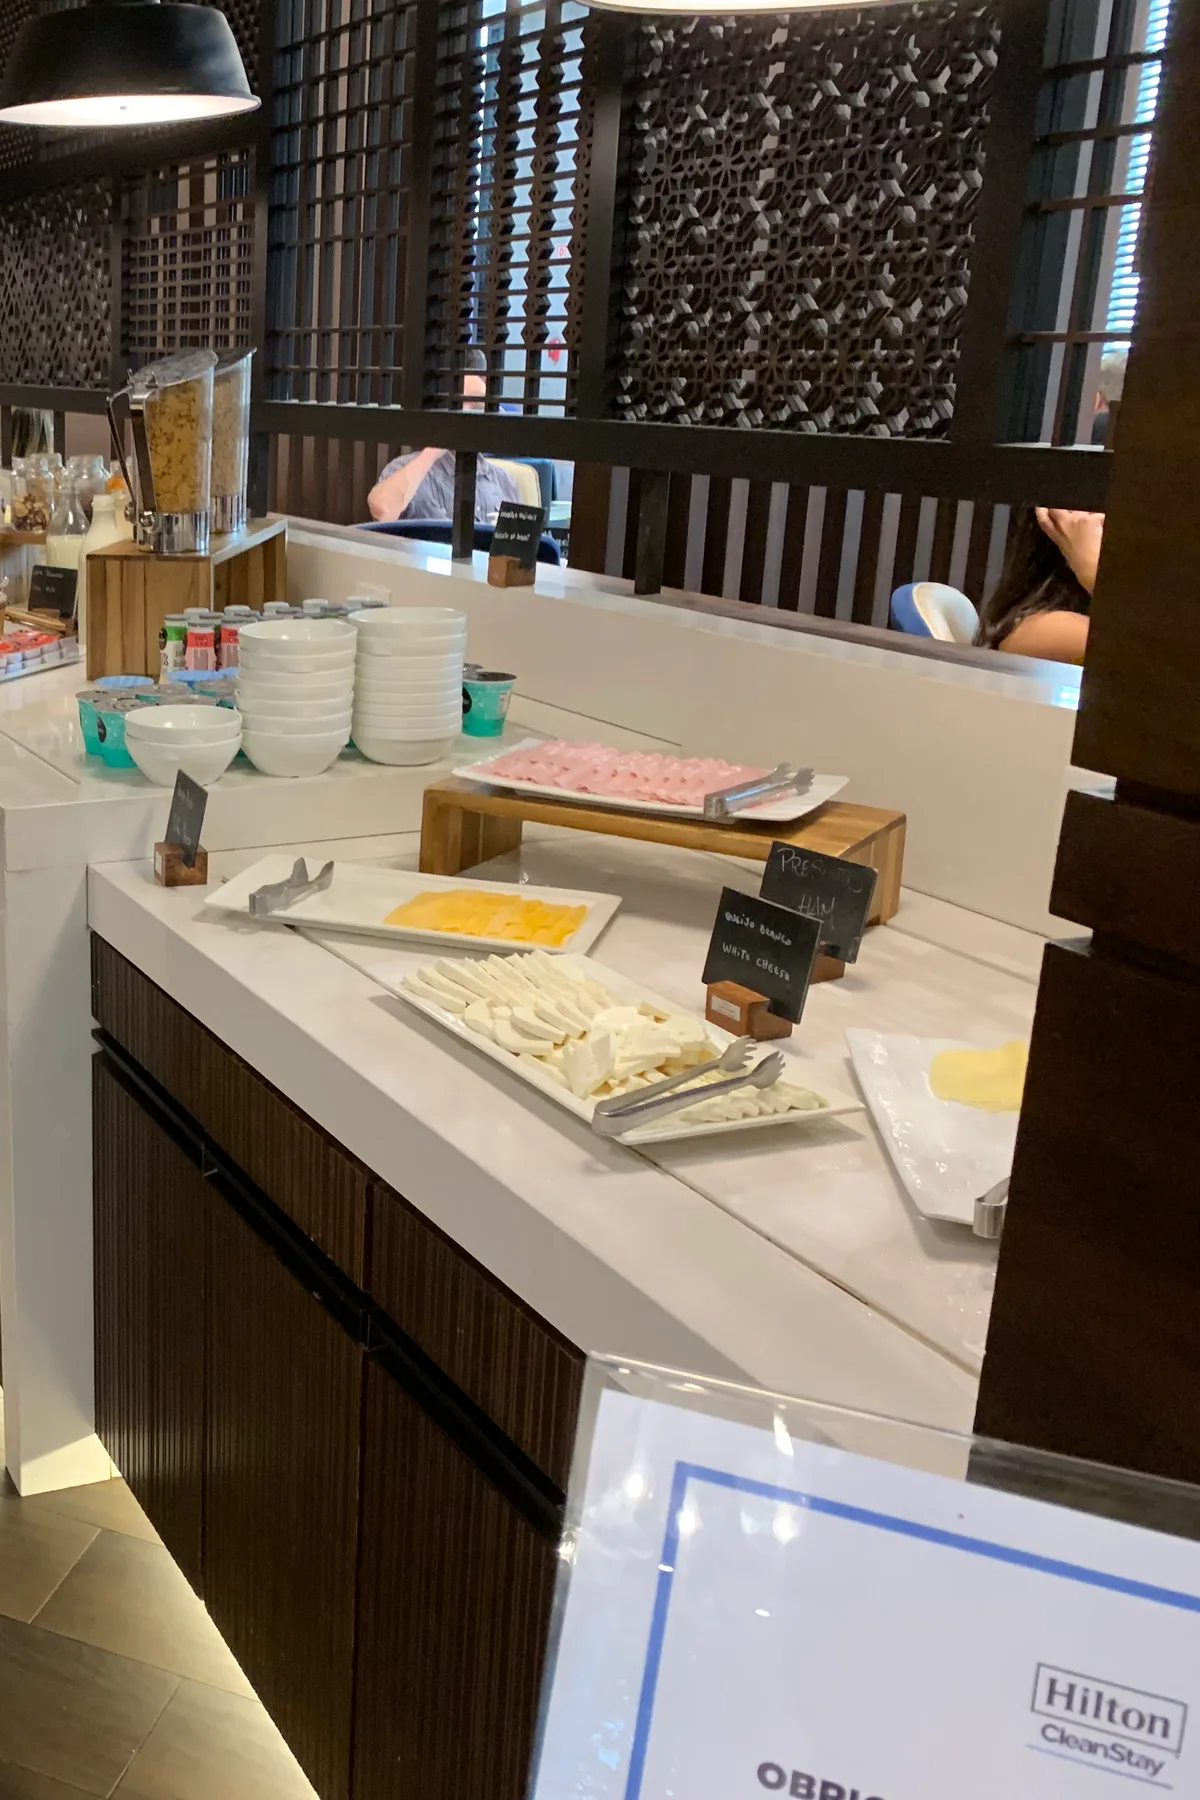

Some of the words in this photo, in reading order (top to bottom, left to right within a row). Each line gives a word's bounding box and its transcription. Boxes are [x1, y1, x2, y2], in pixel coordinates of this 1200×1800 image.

[798, 894, 836, 929] HAM
[1046, 1677, 1171, 1739] Hilton
[1041, 1723, 1165, 1777] CleanStay
